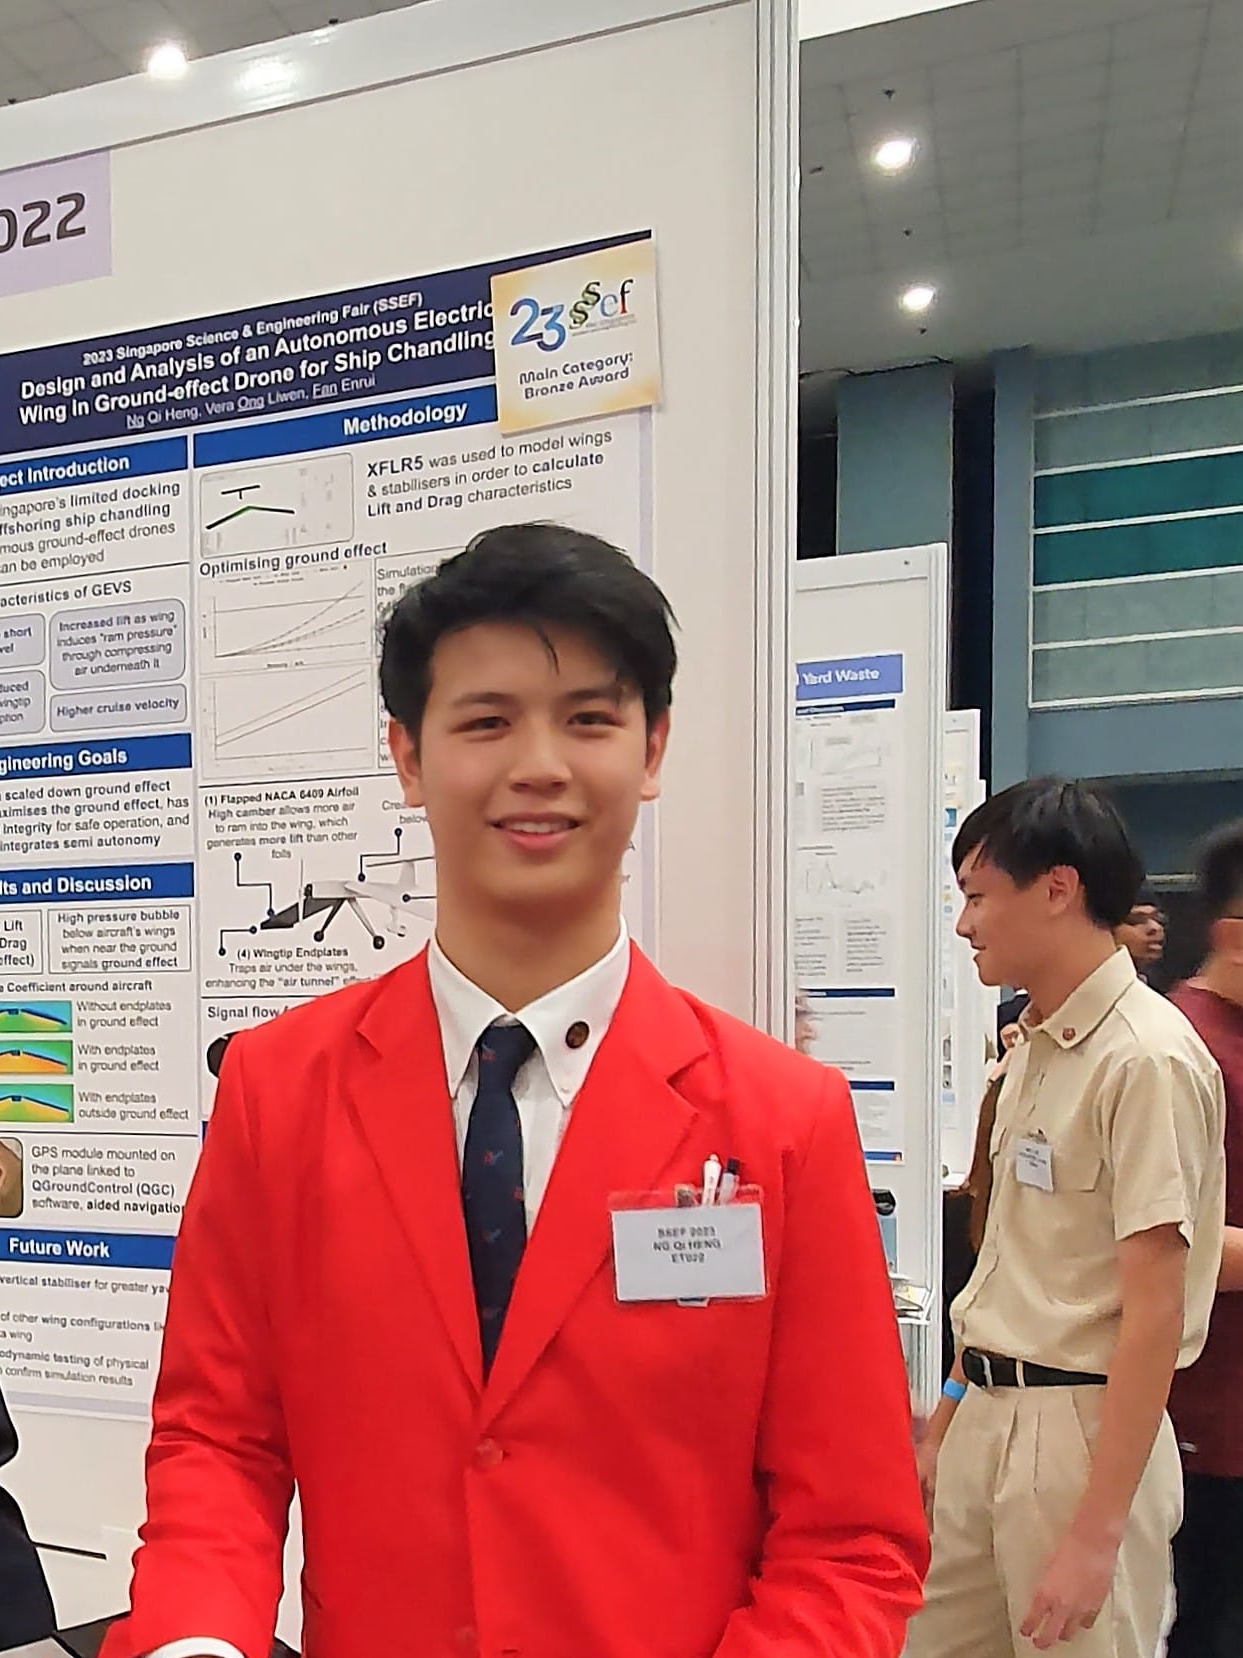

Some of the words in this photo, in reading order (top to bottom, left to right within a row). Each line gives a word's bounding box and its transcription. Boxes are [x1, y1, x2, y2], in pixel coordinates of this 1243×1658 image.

[83, 350, 114, 366] 2023
[116, 340, 182, 360] Singapore
[186, 328, 238, 347] Science
[242, 324, 253, 338] &
[257, 308, 339, 334] Engineering
[342, 299, 370, 318] Fair
[373, 292, 422, 315] (SSEF)
[510, 298, 566, 351] 23
[21, 377, 85, 400] Design
[90, 366, 125, 388] and
[131, 354, 214, 381] Analysis
[221, 349, 240, 366] of
[246, 344, 268, 361] an
[275, 316, 407, 356] Autonomous
[414, 299, 493, 330] Electric
[20, 402, 66, 425] Wing
[95, 375, 228, 412] Ground-effect
[234, 366, 294, 391] Drone
[300, 356, 328, 379] for
[334, 345, 381, 373] Ship
[387, 328, 495, 362] Chandling
[520, 368, 558, 384] Main
[562, 352, 633, 375] Category:
[525, 381, 573, 399] Bronze
[579, 368, 629, 388] Award
[127, 413, 144, 429] Ng
[147, 410, 162, 425] Qi
[206, 402, 234, 415] Vera
[238, 395, 264, 412] Ong
[268, 386, 309, 406] Liwen,
[313, 382, 338, 398] Fan
[341, 375, 376, 392] Enrui
[343, 401, 467, 436] Methodology
[367, 455, 423, 477] XFLR5
[428, 452, 456, 470] was
[461, 447, 495, 464] used
[500, 443, 514, 458] to
[519, 437, 564, 456] model
[568, 430, 612, 451] wings
[28, 456, 129, 483] Introduction
[367, 483, 377, 498] &
[382, 473, 450, 495] stabilisers
[455, 470, 467, 485] in
[471, 465, 508, 483] order
[514, 462, 528, 477] to
[532, 452, 603, 474] calculate
[70, 489, 118, 508] limited
[122, 482, 180, 501] docking
[367, 498, 391, 517] Lift
[396, 495, 422, 513] and
[428, 489, 462, 510] Drag
[467, 477, 572, 503] characteristics
[65, 513, 95, 528] ship
[99, 504, 171, 523] chandling
[38, 529, 125, 552] ground-effect
[129, 522, 175, 538] drones
[21, 558, 37, 571] be
[41, 550, 105, 570] employed
[200, 555, 280, 577] Optimising
[285, 546, 340, 569] ground
[344, 542, 387, 558] effect
[74, 584, 88, 597] of
[91, 581, 132, 597] GEVS
[803, 670, 832, 685] Yard
[835, 669, 879, 682] Waste
[78, 749, 127, 766] Goals
[5, 787, 43, 801] scaled
[47, 786, 82, 798] down
[85, 782, 130, 798] ground
[135, 780, 170, 793] effect
[220, 793, 262, 806] Flapped
[265, 790, 297, 801] NACA
[300, 789, 324, 800] 6409
[327, 787, 359, 797] Airfoil
[51, 803, 71, 815] the
[74, 800, 120, 817] ground
[123, 799, 164, 812] effect,
[167, 796, 189, 809] has
[3, 821, 52, 836] integrity
[56, 819, 72, 832] for
[75, 819, 100, 831] safe
[103, 814, 163, 831] operation,
[167, 812, 190, 826] and
[0, 839, 60, 853] integrates
[63, 836, 94, 850] semi
[97, 833, 161, 849] autonomy
[22, 879, 52, 895] and
[57, 874, 151, 893] Discussion
[4, 920, 23, 932] Lift
[0, 938, 27, 953] Drag
[237, 948, 250, 960] (4)
[253, 948, 293, 960] Wingtip
[296, 946, 348, 959] Endplates
[7, 981, 67, 992] Coefficient
[69, 981, 109, 992] around
[112, 980, 153, 991] aircraft
[208, 1006, 248, 1022] Signal
[252, 1005, 279, 1019] flow
[32, 1180, 133, 1194] QGroundControl
[136, 1182, 175, 1197] (QGC)
[9, 1238, 61, 1256] Future
[66, 1240, 110, 1258] Work
